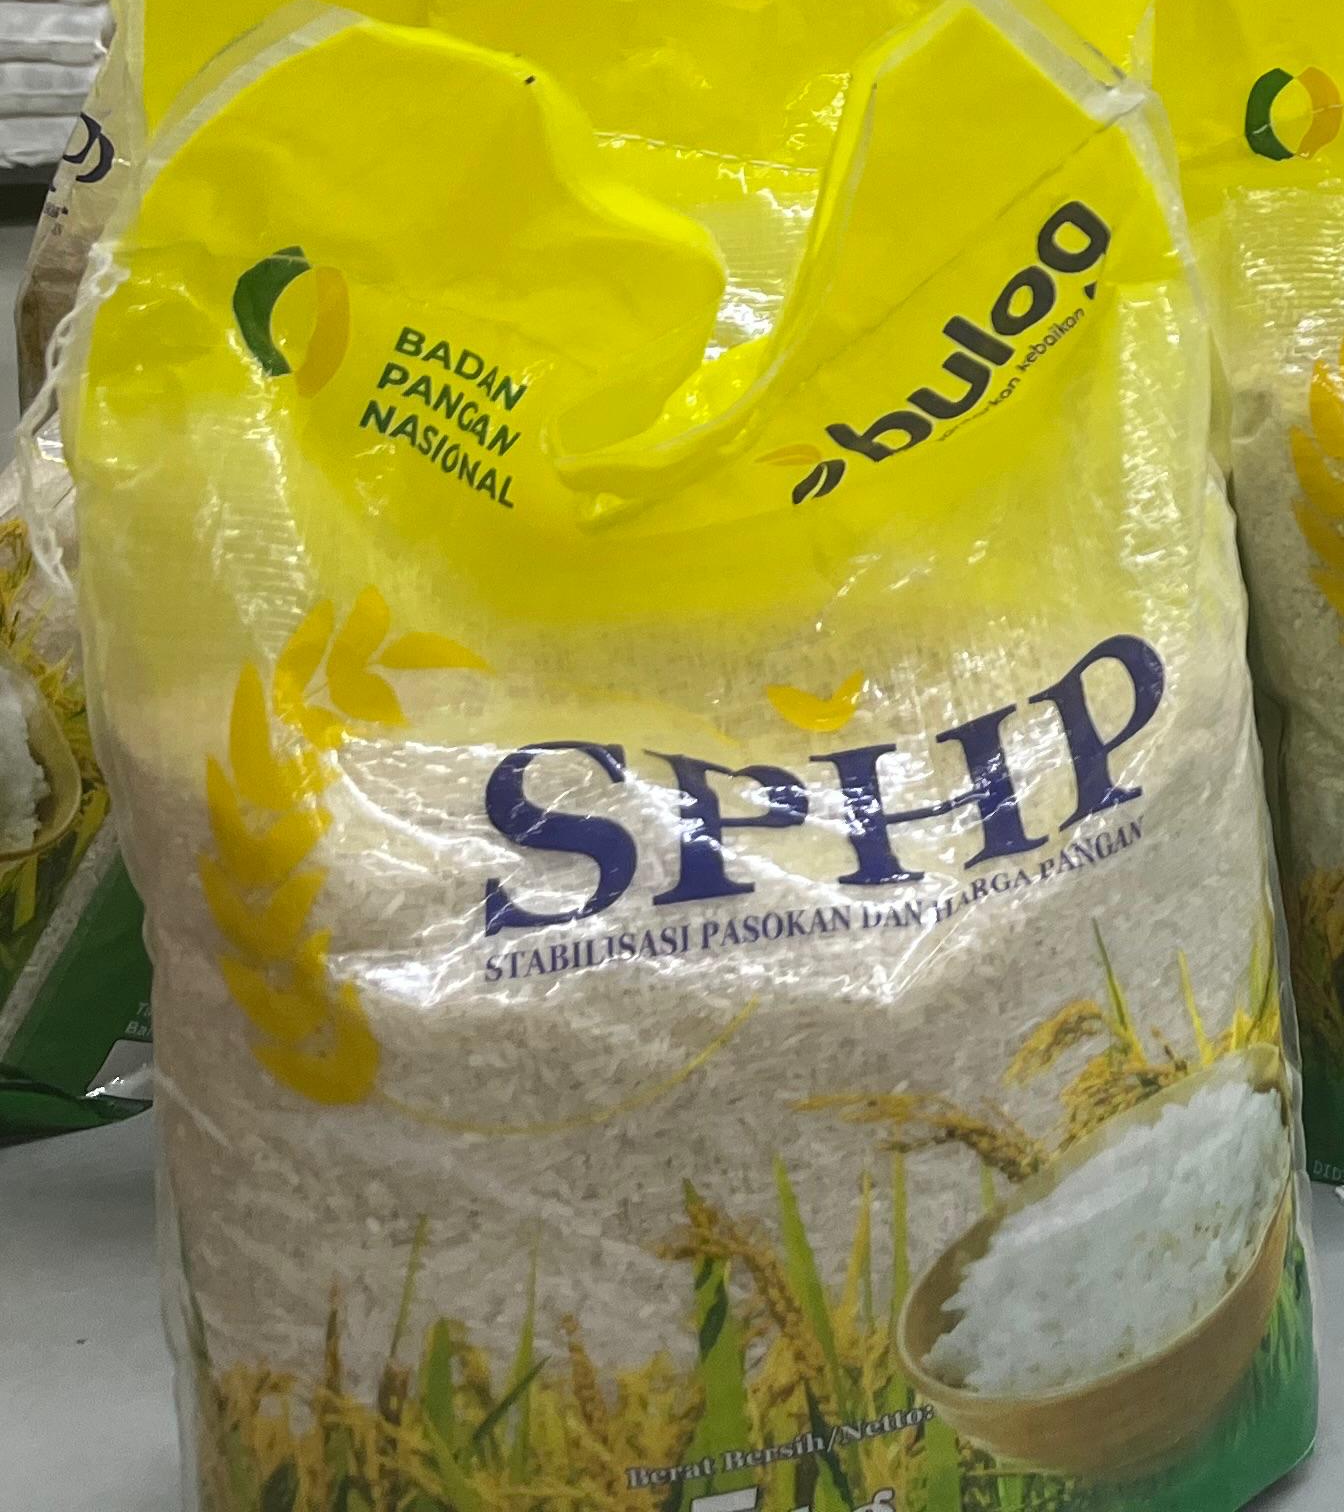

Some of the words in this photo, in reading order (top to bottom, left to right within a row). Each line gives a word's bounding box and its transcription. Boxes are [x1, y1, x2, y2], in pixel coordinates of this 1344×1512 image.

[376, 361, 522, 457] PANGAN
[394, 325, 529, 412] BADAN
[358, 399, 515, 509] NASIONAL
[484, 634, 1167, 938] SPHP
[484, 924, 692, 983] STABILISASI
[701, 904, 851, 951] PASOKAN
[1040, 815, 1145, 880] PANGAN
[625, 1457, 716, 1488] Berat
